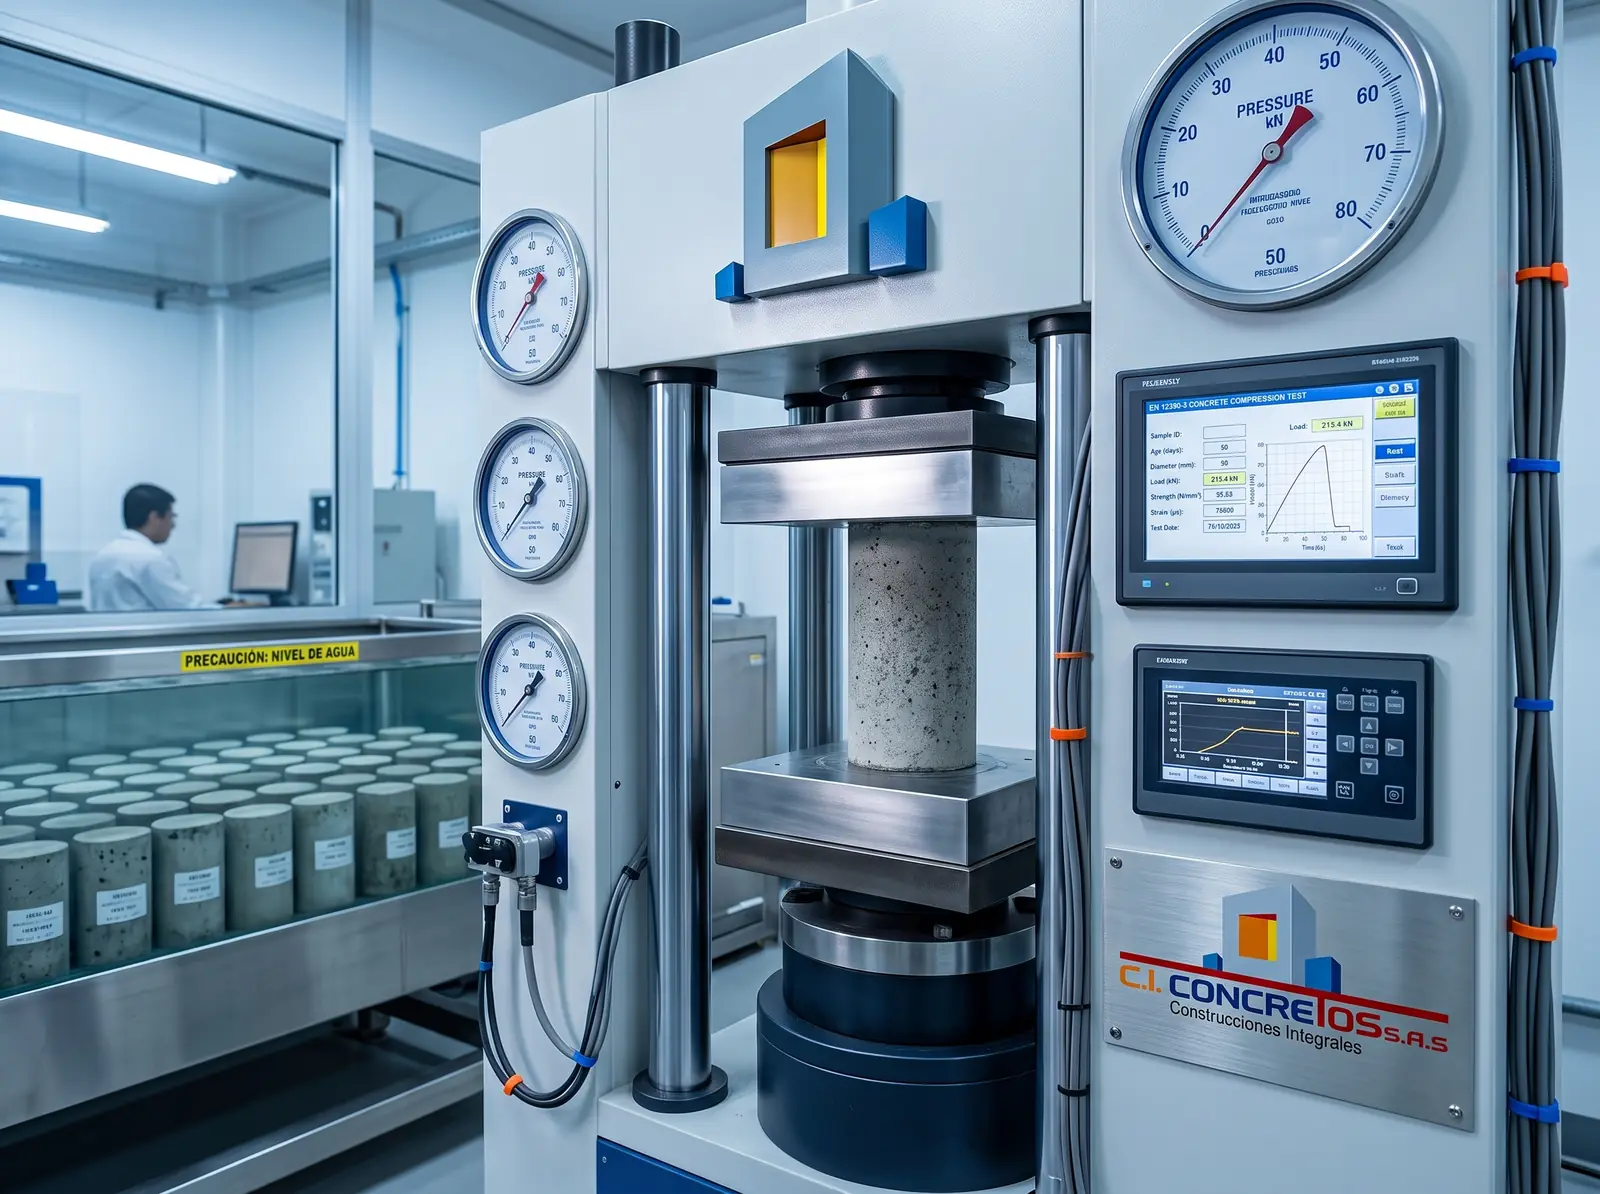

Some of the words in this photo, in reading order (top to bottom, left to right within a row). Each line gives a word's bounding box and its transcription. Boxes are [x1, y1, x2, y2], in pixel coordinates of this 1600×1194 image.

[1264, 46, 1284, 64] 40
[1319, 51, 1340, 70] 50
[1212, 78, 1231, 96] 30
[1356, 85, 1378, 104] 60
[1237, 89, 1314, 118] PRESSURE
[1266, 114, 1284, 129] kN
[1178, 125, 1198, 142] 20
[1364, 143, 1386, 162] 70
[1172, 181, 1189, 198] 10
[1335, 200, 1357, 219] 80
[528, 240, 536, 250] 40
[510, 256, 518, 266] 30
[1266, 248, 1286, 266] 50
[499, 281, 506, 290] 20
[560, 296, 568, 306] 70
[498, 310, 504, 318] 10
[528, 348, 536, 358] 50
[1189, 399, 1228, 408] CONCRETE
[1230, 394, 1286, 404] COMPRESSION
[1287, 392, 1307, 400] TEST
[1322, 421, 1341, 429] 215.4
[1343, 420, 1353, 428] kN
[1150, 432, 1172, 440] Sample
[1163, 446, 1184, 454] (days):
[512, 456, 518, 464] 30
[545, 454, 552, 462] 50
[1178, 462, 1196, 470] (mm):
[502, 476, 508, 485] 20
[556, 474, 563, 482] 60
[1166, 477, 1180, 485] (kN):
[1150, 493, 1176, 501] Strength
[498, 501, 505, 510] 10
[528, 641, 536, 649] 40
[185, 650, 268, 667] PRECAUCIÓN:
[272, 649, 304, 662] NIVEL
[308, 648, 322, 659] DE
[325, 646, 354, 658] AGUA
[512, 648, 519, 656] 30
[502, 665, 508, 673] 20
[558, 694, 566, 702] 70
[529, 736, 536, 744] 50
[1120, 964, 1162, 993] C.I.
[1170, 1000, 1280, 1037] Construcciones
[1286, 1024, 1362, 1055] Integrales
